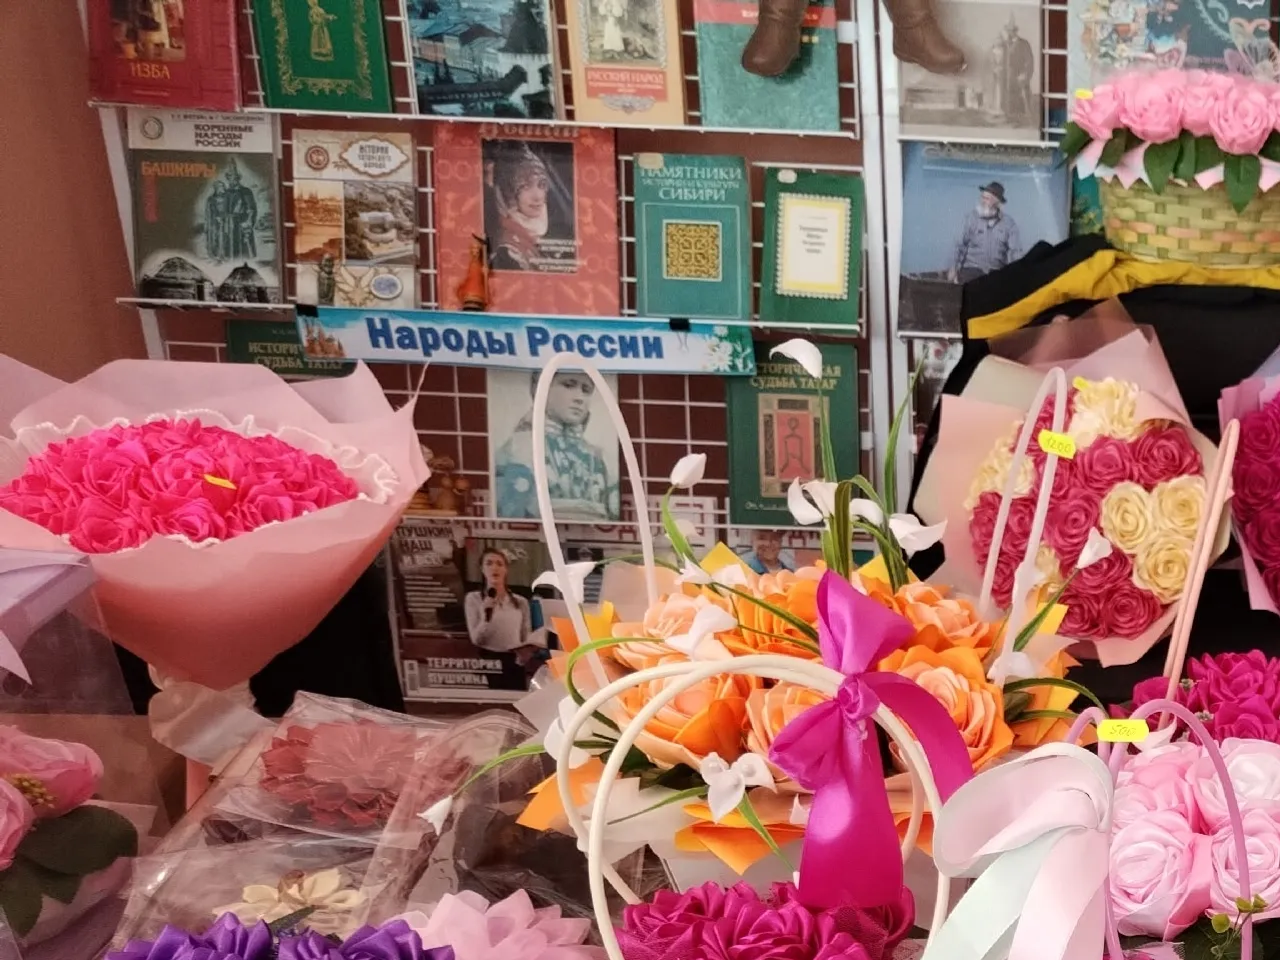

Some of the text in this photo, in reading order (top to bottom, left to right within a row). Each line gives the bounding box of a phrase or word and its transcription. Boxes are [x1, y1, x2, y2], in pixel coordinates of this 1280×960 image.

[130, 62, 171, 80] ИЗБА
[141, 161, 217, 179] БАШКИРЫ
[641, 166, 743, 180] ПАМЯТНИКИ
[659, 187, 726, 201] СИБИРИ
[365, 317, 665, 360] Народы России
[426, 657, 503, 671] ТЕРРИТОРИЯ
